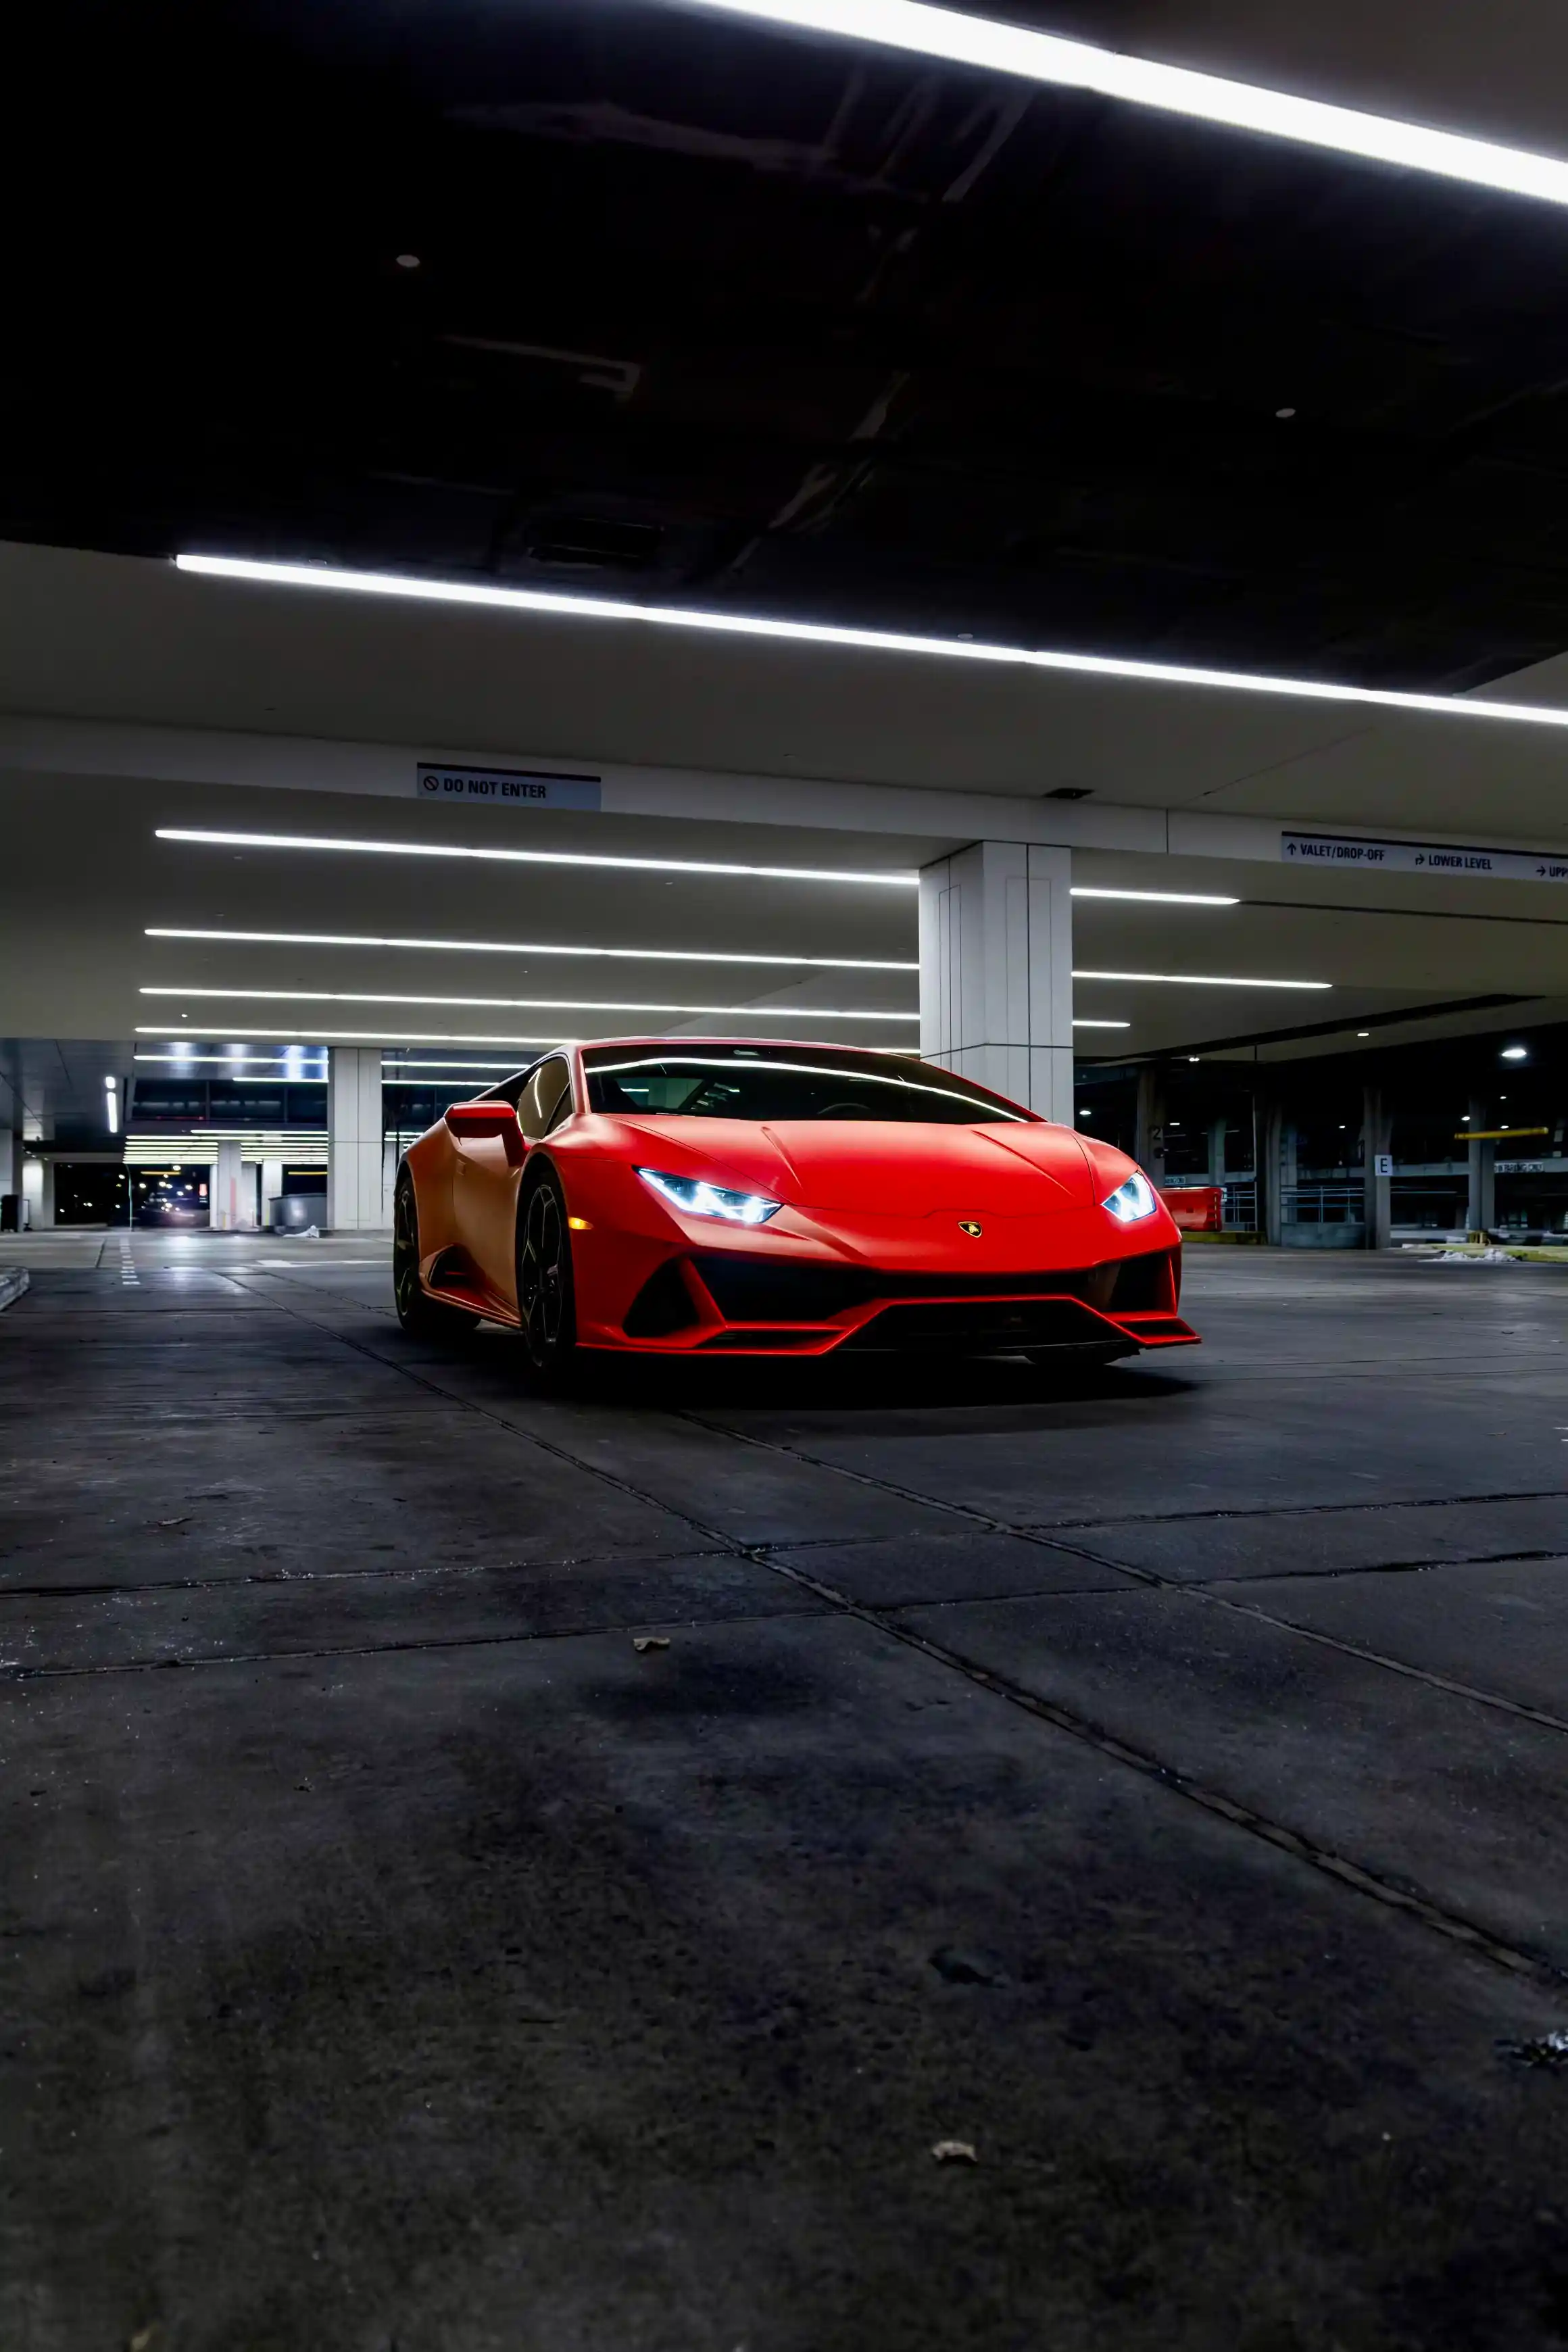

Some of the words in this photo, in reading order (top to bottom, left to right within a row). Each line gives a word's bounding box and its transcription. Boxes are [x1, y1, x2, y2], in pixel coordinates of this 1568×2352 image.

[444, 779, 464, 793] DO
[468, 780, 498, 795] NOT
[501, 783, 547, 799] ENTER
[1300, 843, 1386, 861] VALET/DROP-OFF
[1429, 854, 1463, 867] LOWER
[1465, 858, 1492, 870] LEVEL
[1380, 1157, 1388, 1173] E
